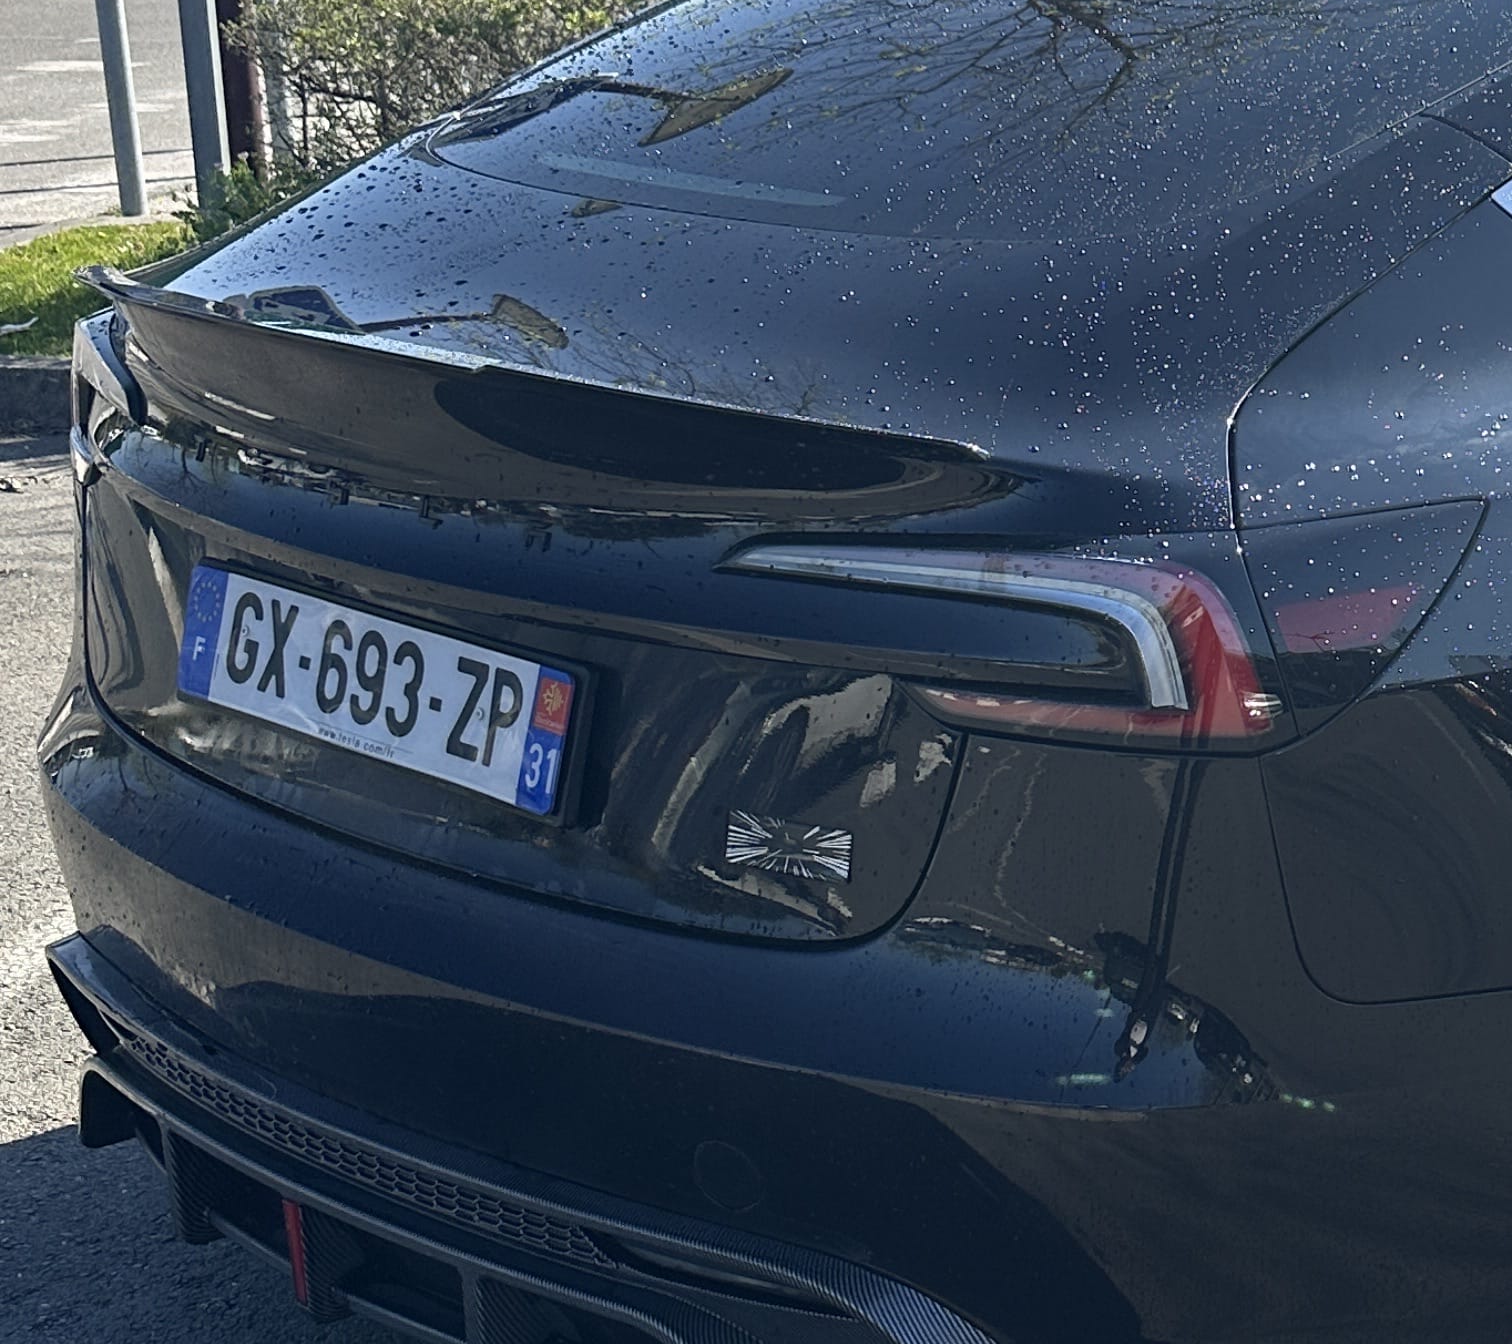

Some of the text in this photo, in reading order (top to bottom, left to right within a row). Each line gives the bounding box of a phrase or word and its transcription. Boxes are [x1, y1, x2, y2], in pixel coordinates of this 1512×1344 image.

[192, 636, 206, 661] F
[226, 592, 524, 767] GX-693-ZP
[525, 743, 557, 794] 31
